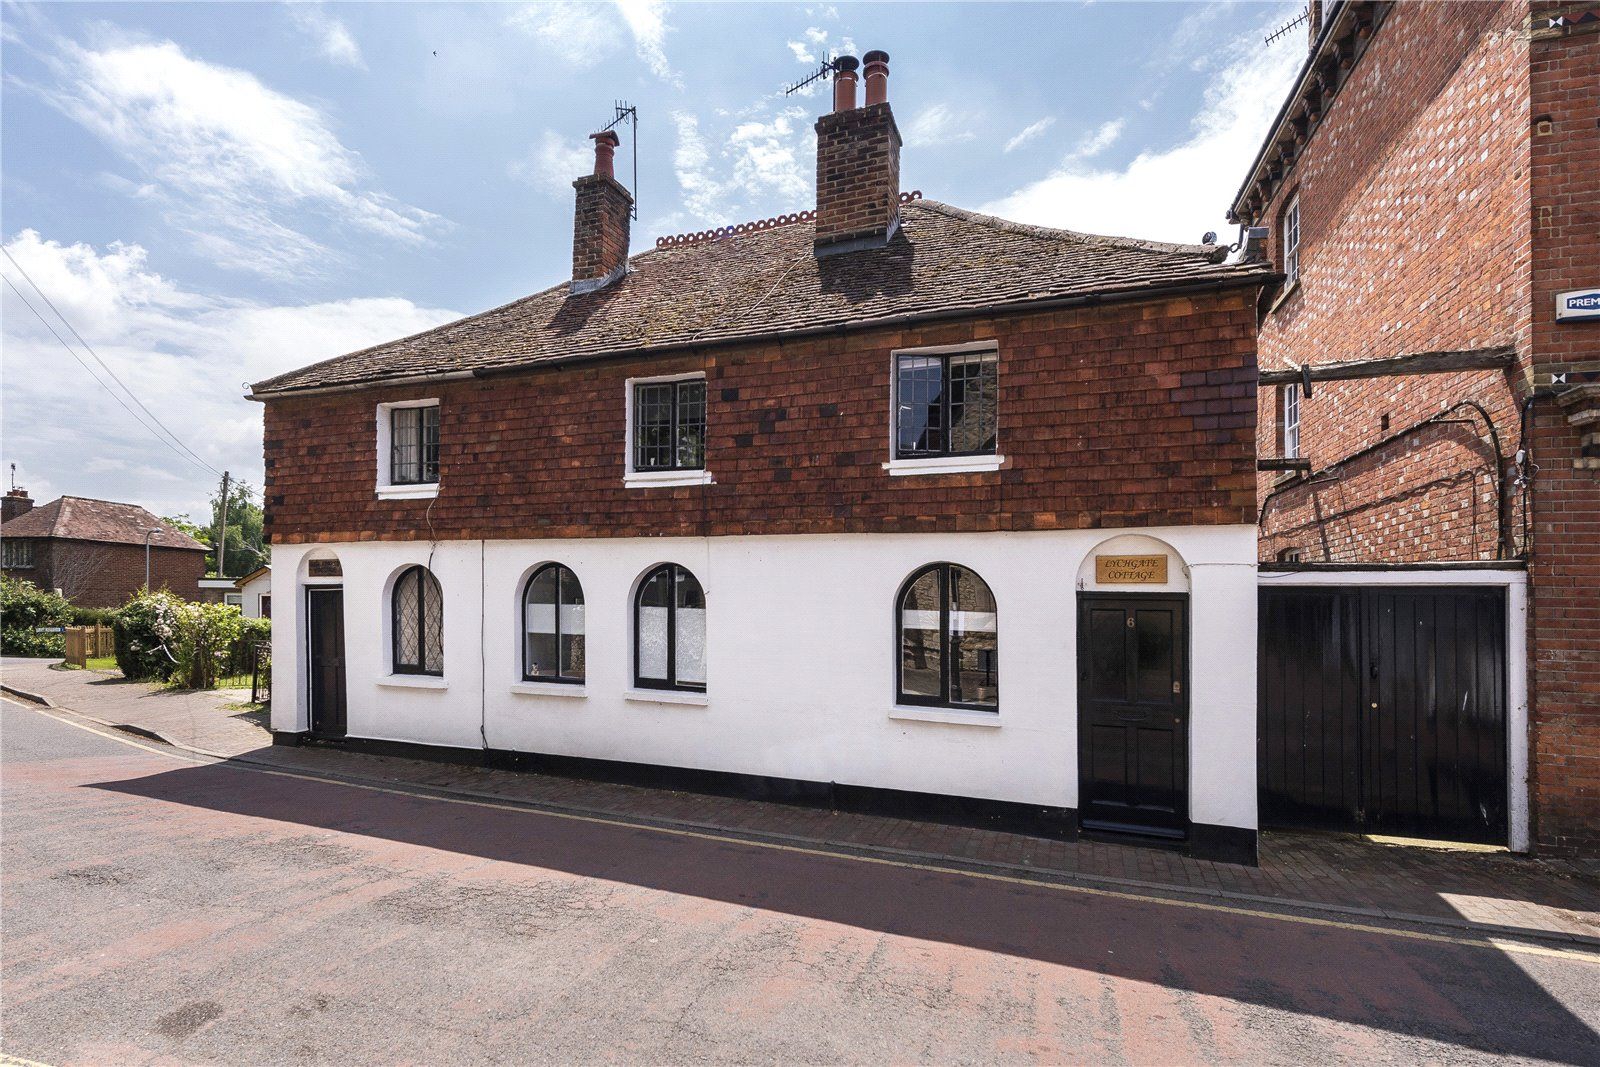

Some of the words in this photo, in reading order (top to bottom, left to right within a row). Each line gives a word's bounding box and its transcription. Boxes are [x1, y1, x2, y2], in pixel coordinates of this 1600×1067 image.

[1105, 559, 1159, 569] LYCHGATE
[1108, 571, 1156, 581] COTTAGE
[1126, 617, 1135, 628] 6
